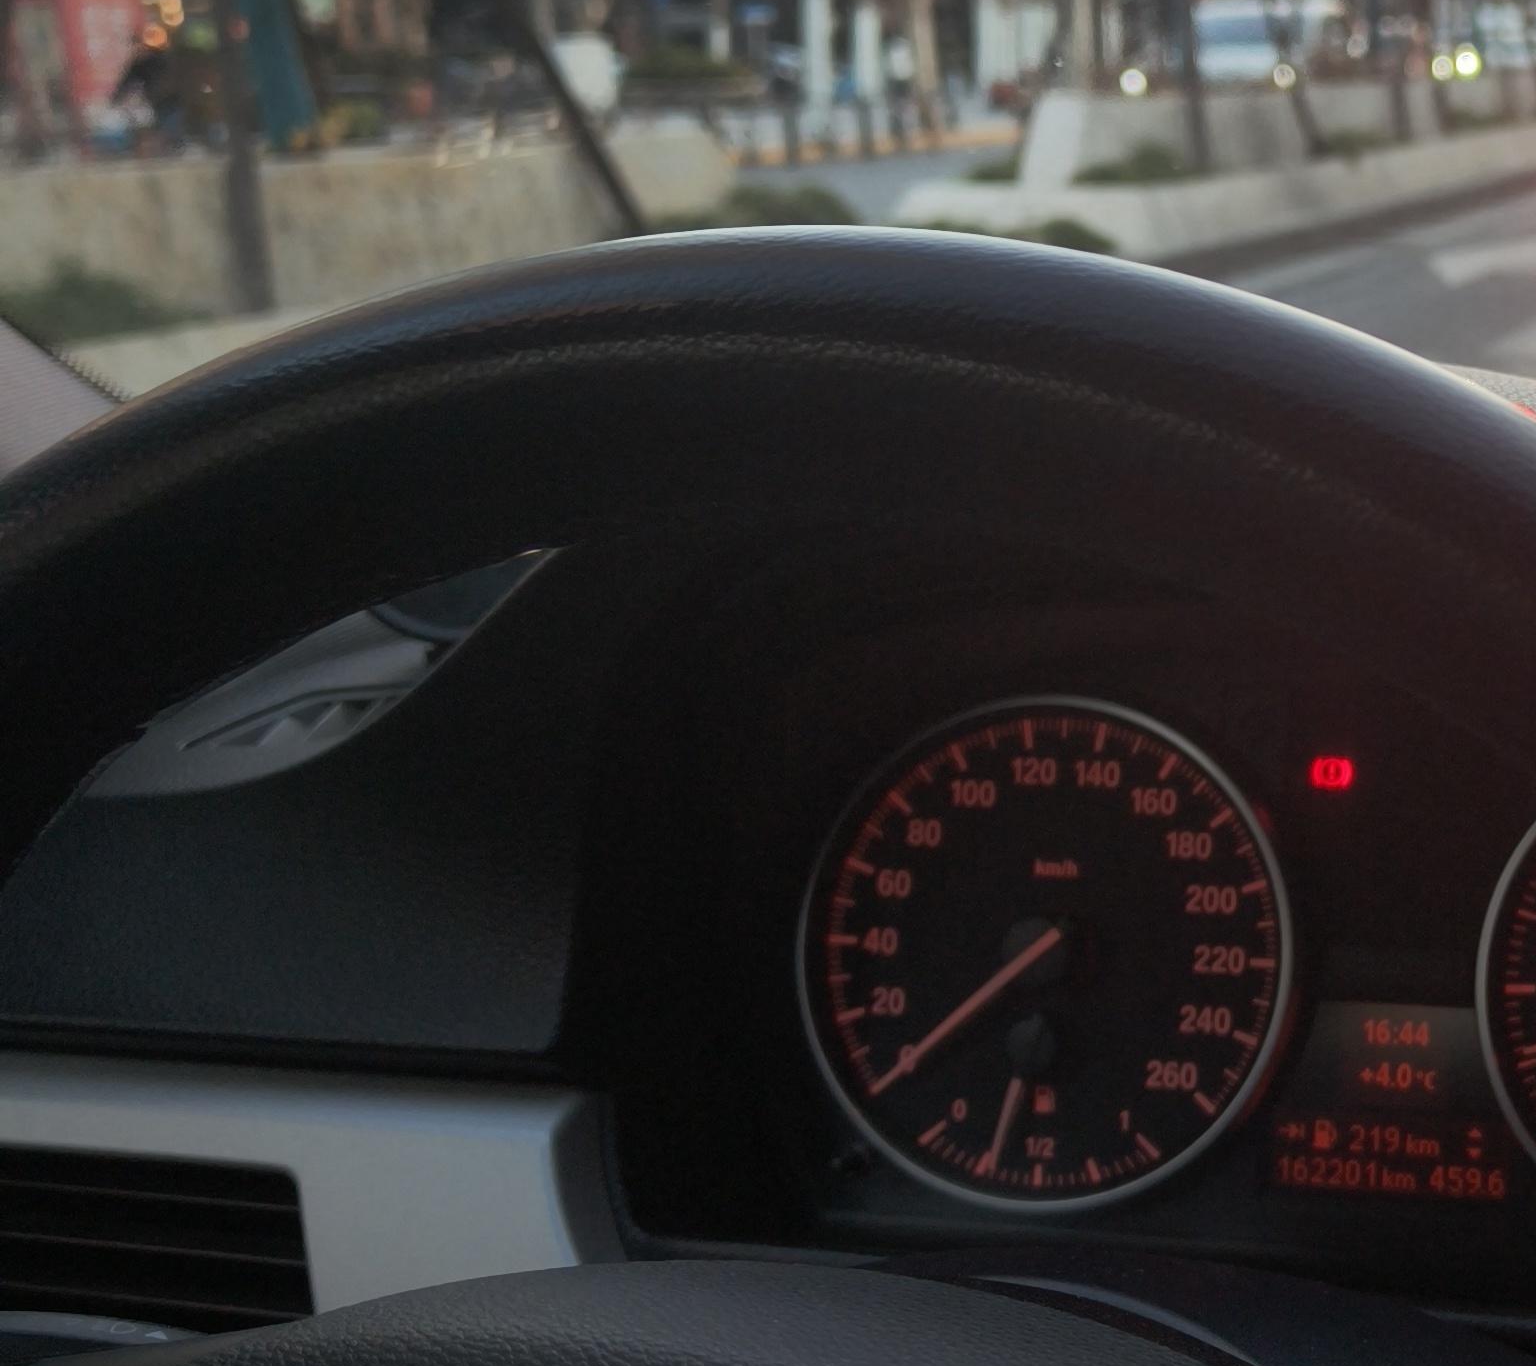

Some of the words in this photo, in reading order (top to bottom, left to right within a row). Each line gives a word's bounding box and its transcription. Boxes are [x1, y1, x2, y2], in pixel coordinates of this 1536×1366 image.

[1012, 759, 1056, 785] 120
[1076, 761, 1121, 787] 140
[951, 781, 995, 807] 100
[1132, 789, 1176, 816] 160
[907, 820, 941, 848] 80
[1166, 832, 1212, 860] 180
[877, 870, 911, 898] 60
[1185, 886, 1237, 914] 200
[863, 928, 898, 954] 40
[1194, 946, 1245, 973] 220
[872, 987, 905, 1014] 20
[1180, 1006, 1231, 1033] 240
[1363, 1019, 1431, 1046] 16:44
[1145, 1060, 1197, 1089] 260
[951, 1099, 967, 1123] 0
[1120, 1110, 1130, 1132] 1
[1025, 1135, 1055, 1158] 1/2
[1350, 1124, 1402, 1153] 219
